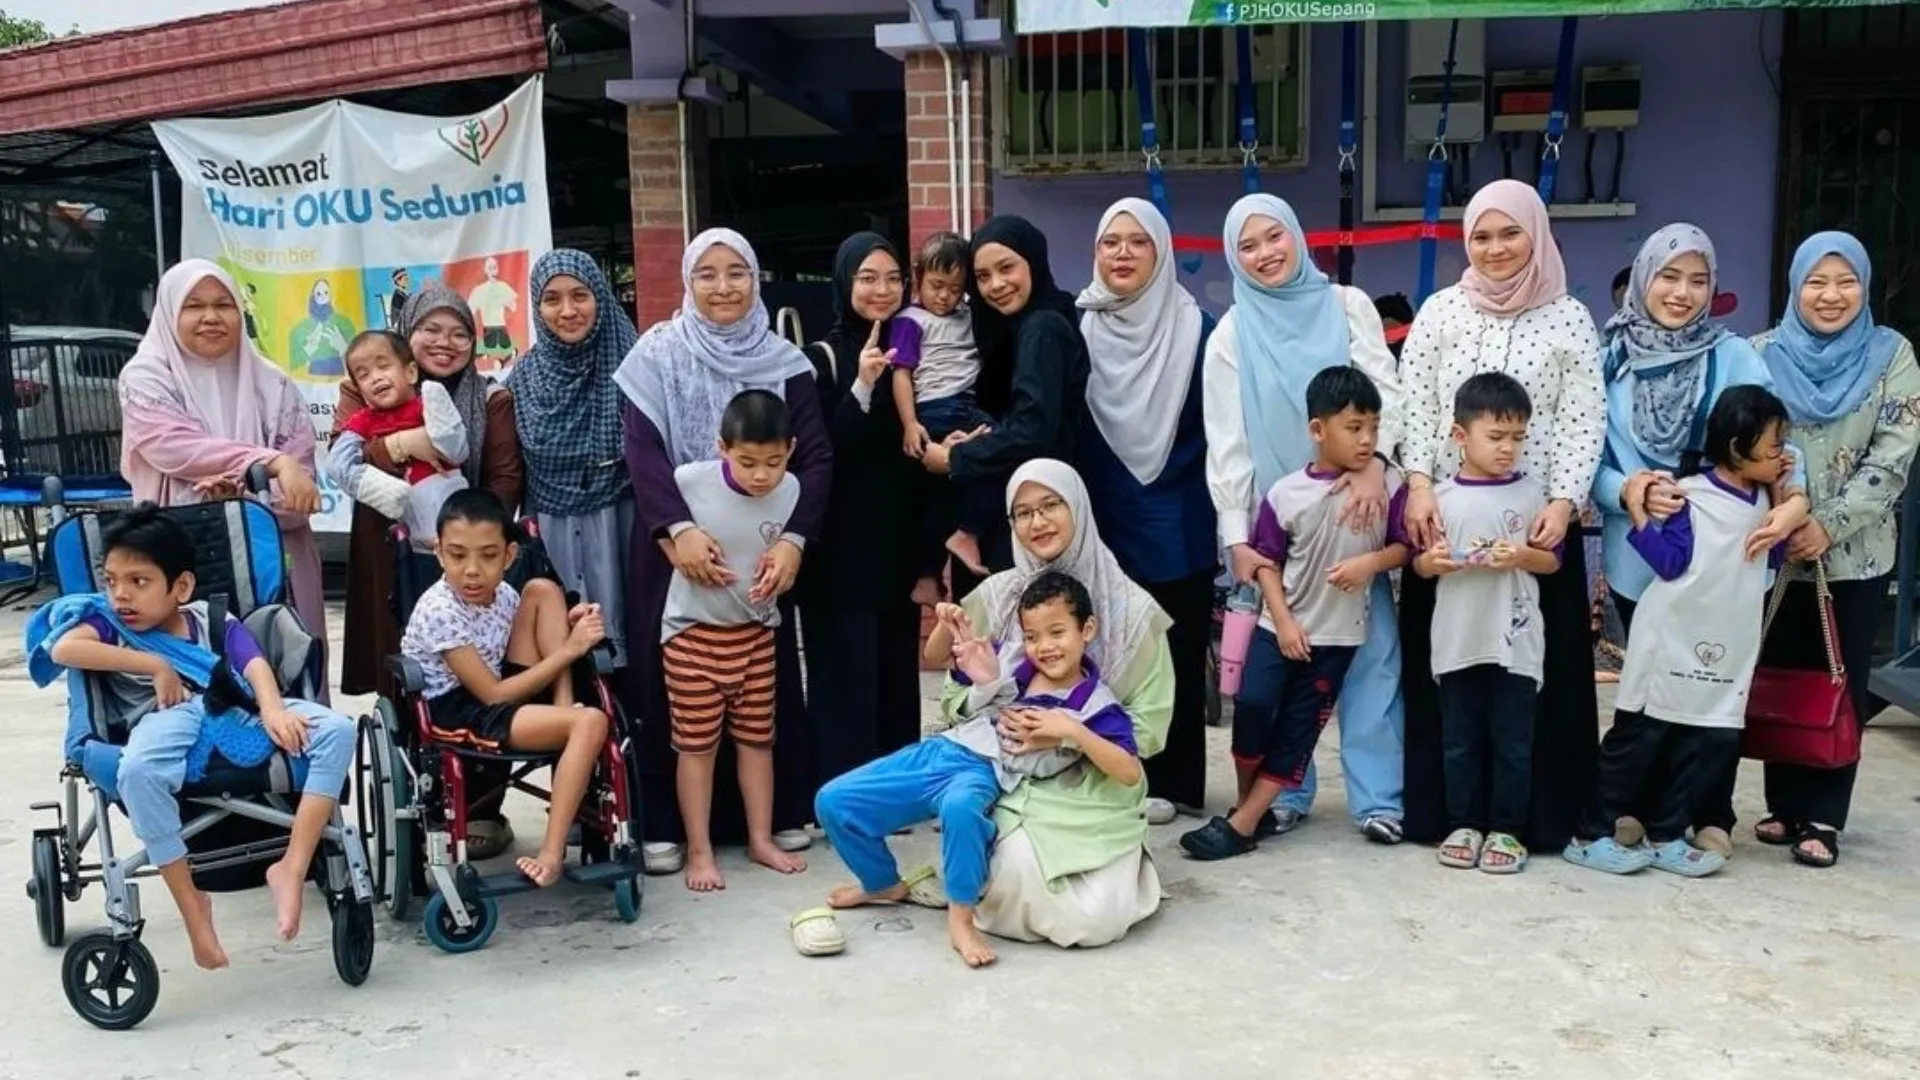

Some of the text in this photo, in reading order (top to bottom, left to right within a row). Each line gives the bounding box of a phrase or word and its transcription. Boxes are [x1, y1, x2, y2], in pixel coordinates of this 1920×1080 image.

[1239, 1, 1375, 18] PJHOKUSepang
[198, 152, 330, 188] Selamat
[206, 173, 527, 230] Hari OKU Sedunia
